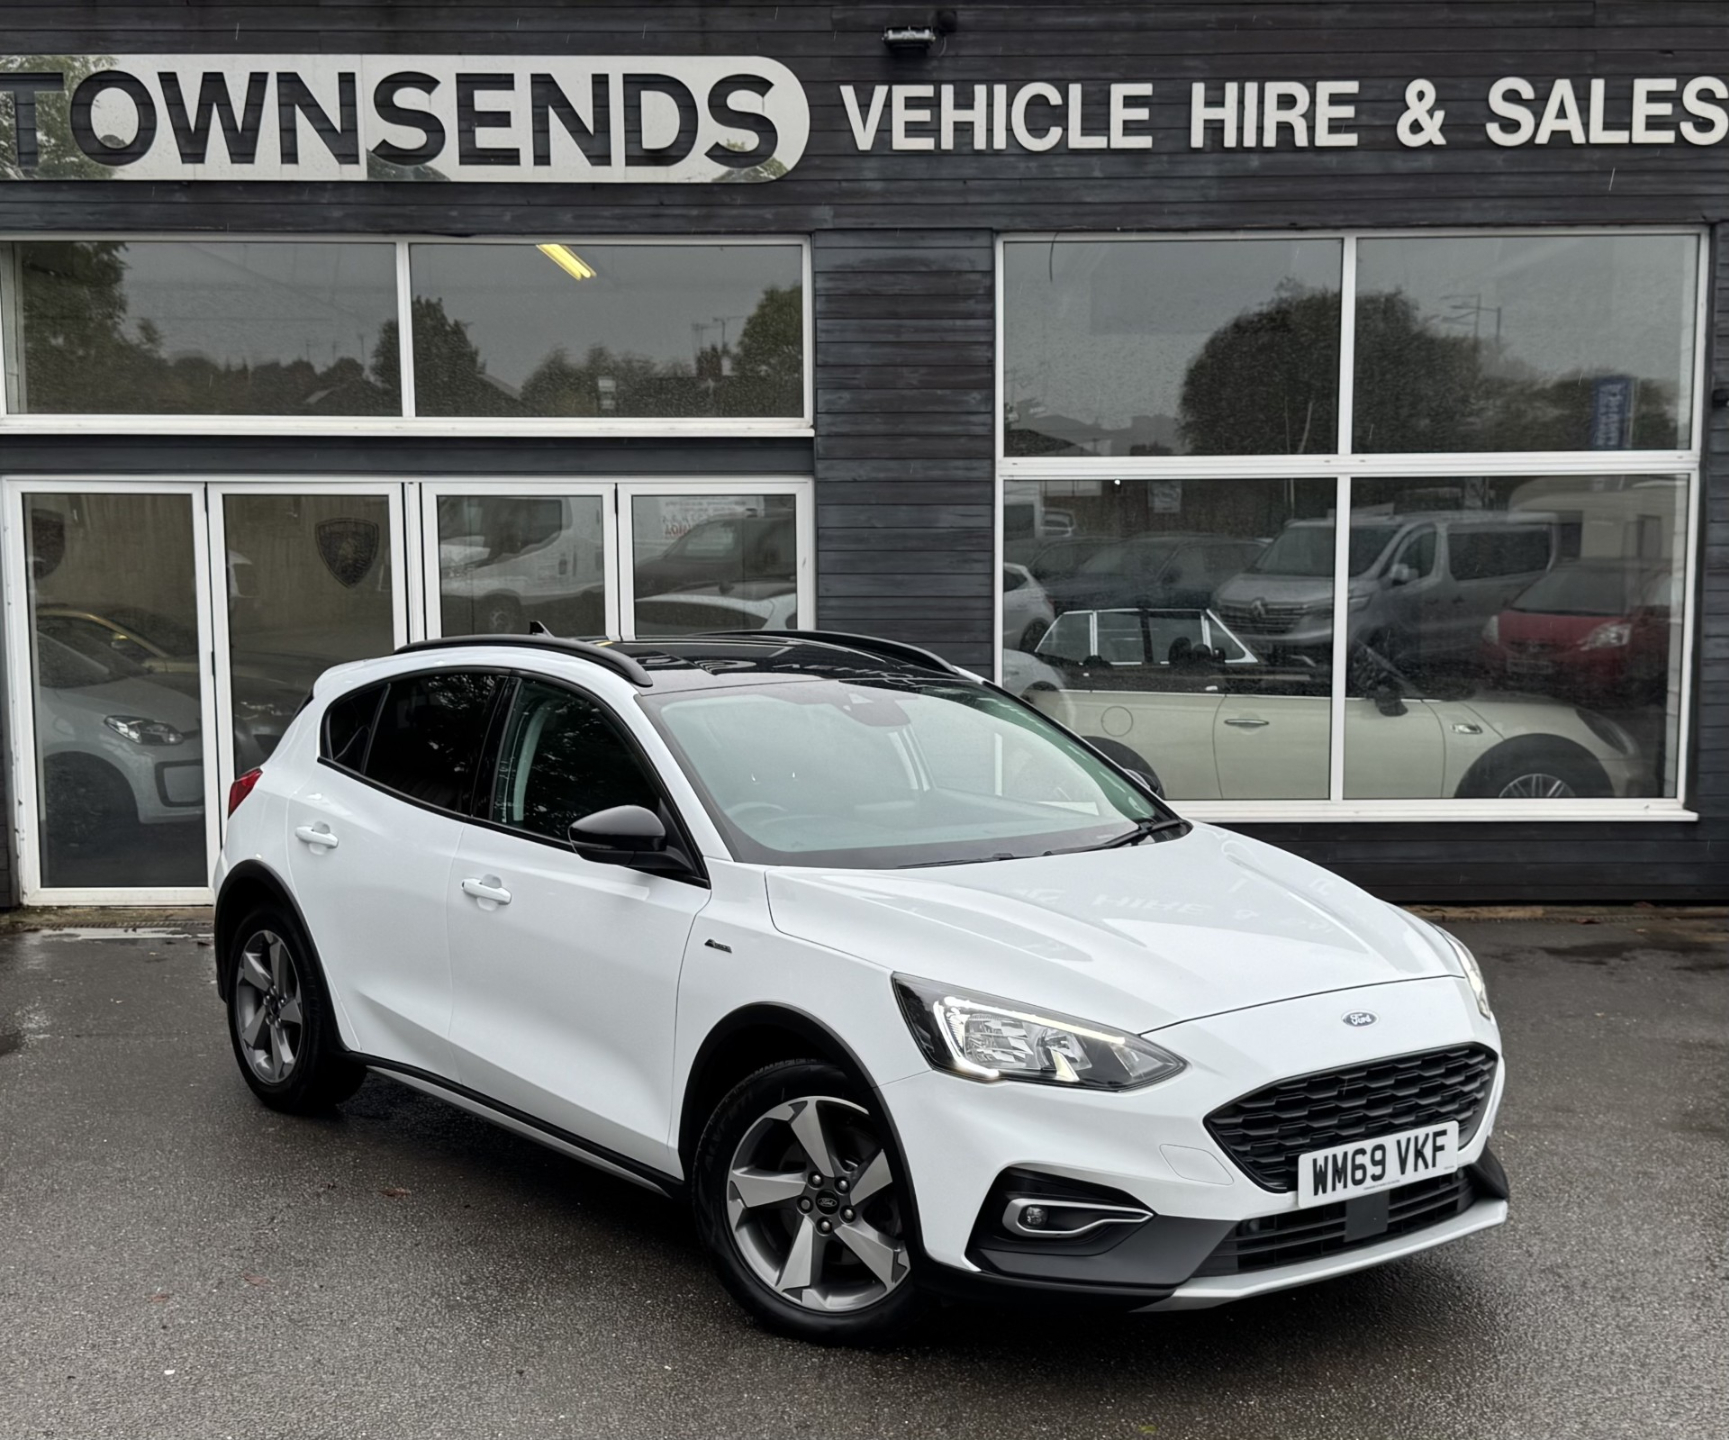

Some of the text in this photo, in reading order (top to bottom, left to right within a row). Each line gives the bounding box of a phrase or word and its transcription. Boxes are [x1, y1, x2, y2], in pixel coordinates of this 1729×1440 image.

[0, 70, 779, 169] TOWNSENDS
[839, 76, 1729, 151] VEHICLE HIRE & SALES
[1312, 1129, 1448, 1196] WM69 VKF
